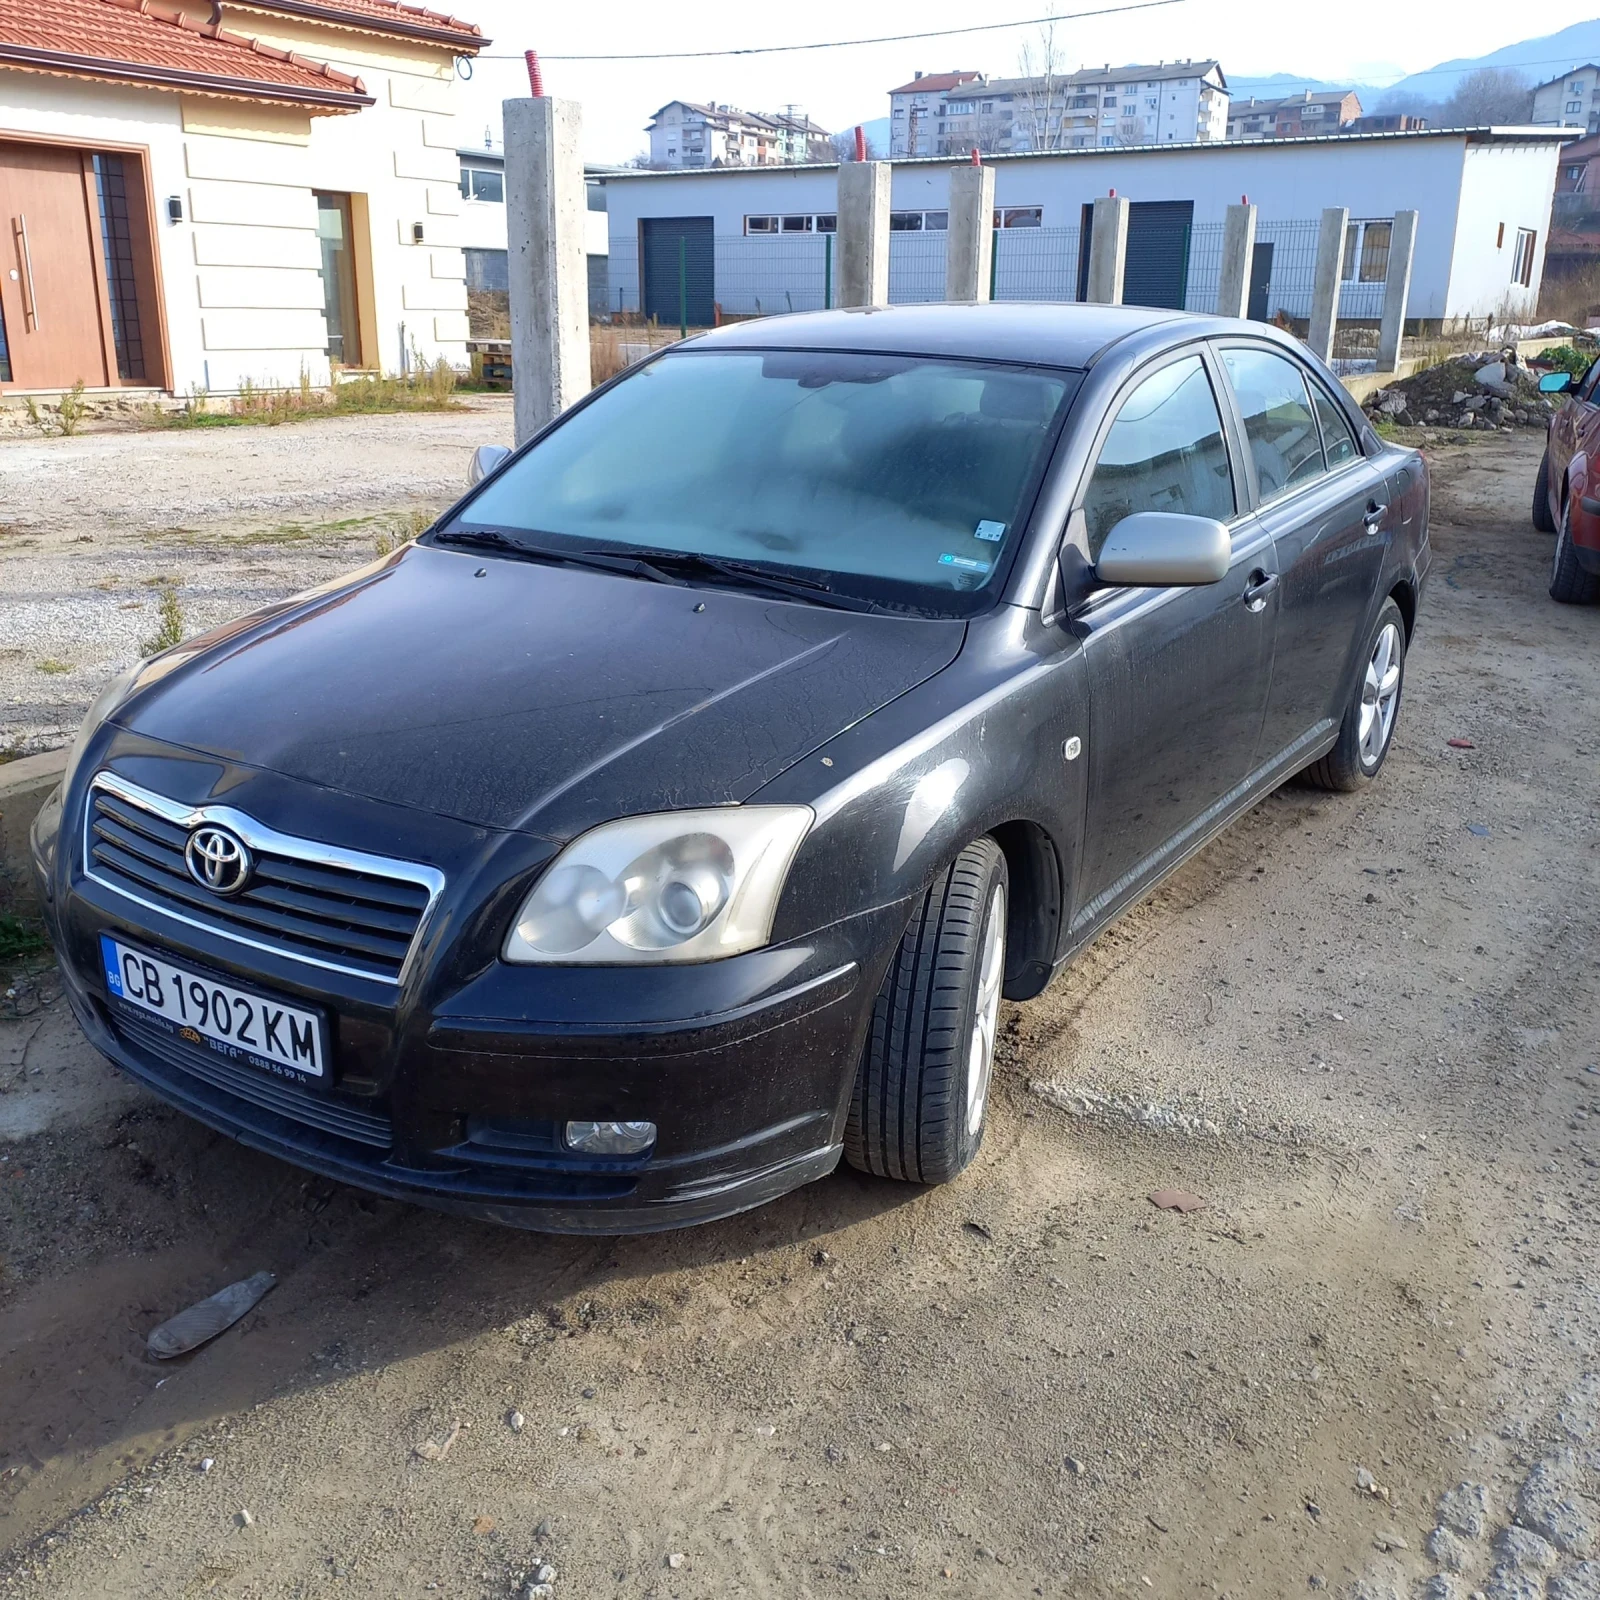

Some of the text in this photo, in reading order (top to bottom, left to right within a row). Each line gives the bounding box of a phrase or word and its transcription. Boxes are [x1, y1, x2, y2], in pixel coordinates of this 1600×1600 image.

[107, 971, 121, 988] BG
[284, 1068, 295, 1080] 99
[297, 1073, 307, 1083] 14
